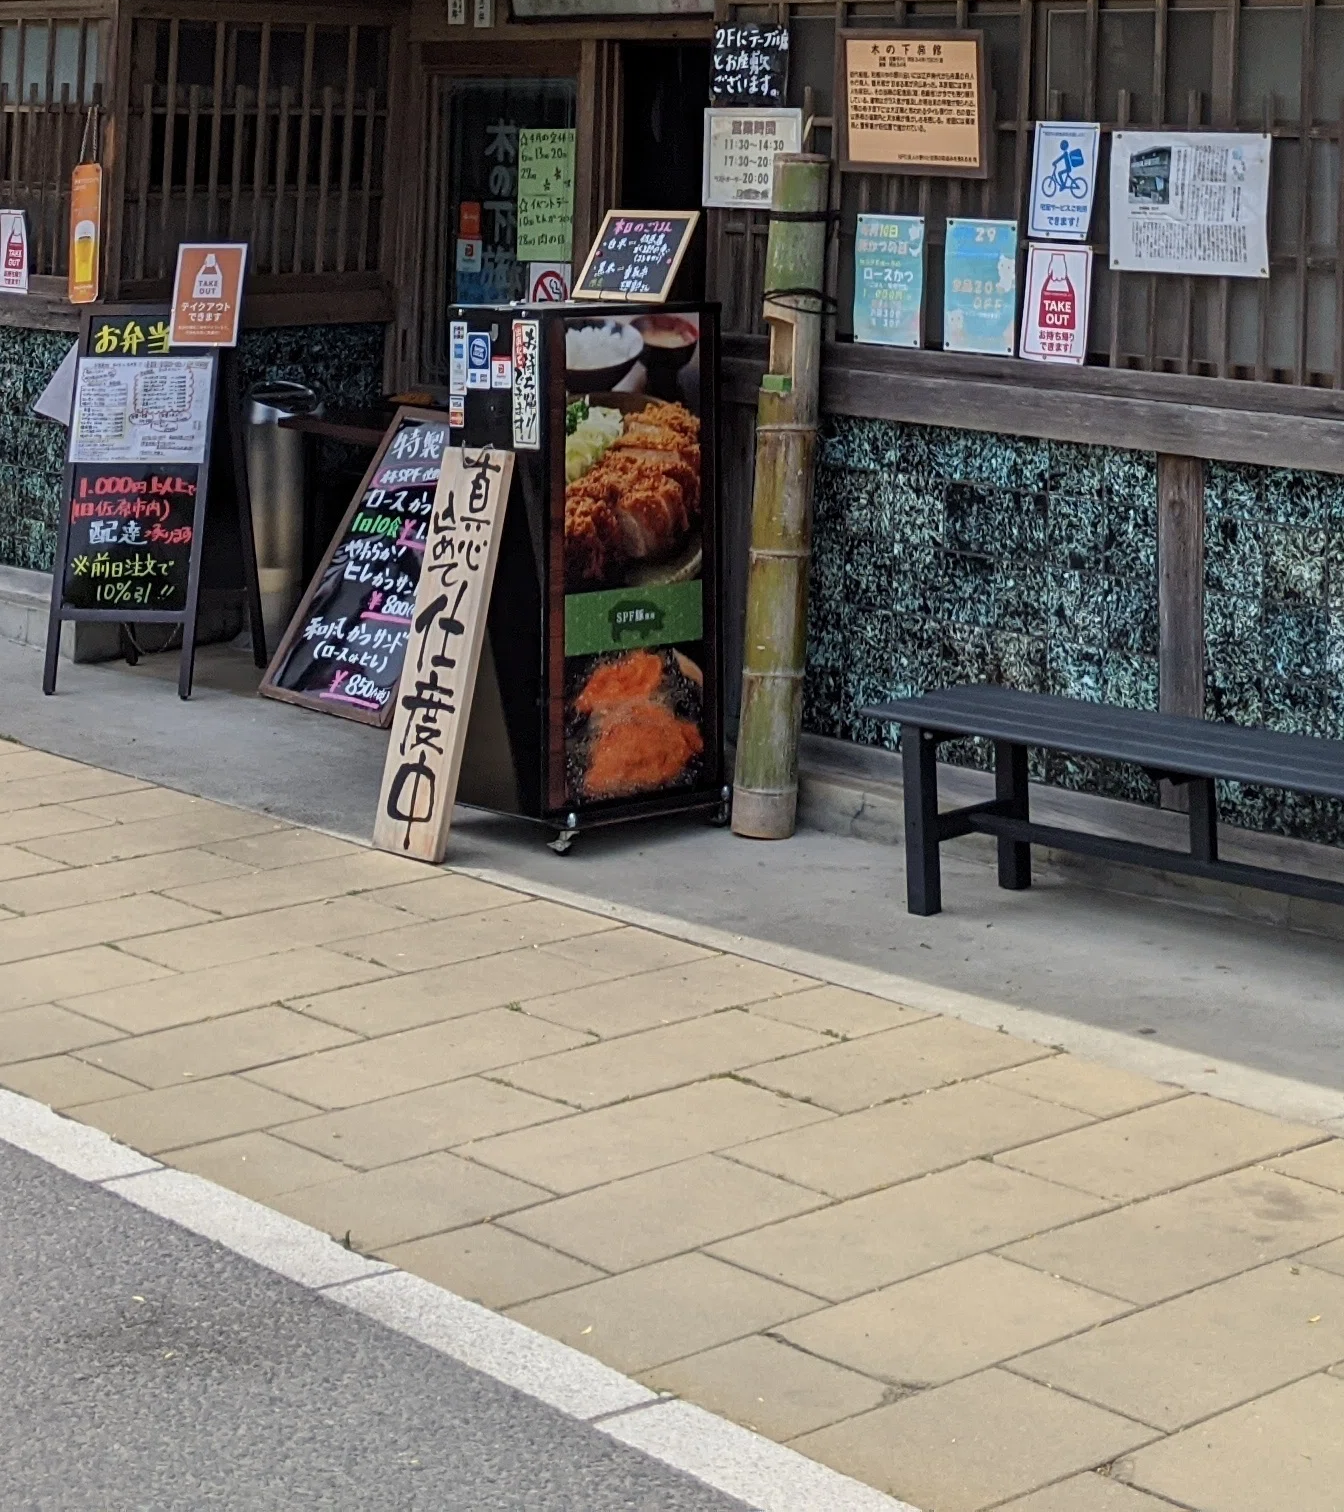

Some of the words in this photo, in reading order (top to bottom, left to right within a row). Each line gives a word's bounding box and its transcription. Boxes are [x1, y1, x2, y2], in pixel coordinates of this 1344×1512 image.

[732, 120, 777, 136] 営業時間
[863, 267, 914, 283] ロースかつ
[181, 302, 231, 312] テイクアウト
[1043, 299, 1072, 313] TAKE
[1045, 313, 1070, 326] OUT
[94, 320, 170, 355] お弁当
[392, 430, 444, 460] 特製
[458, 453, 502, 571] 真心
[426, 490, 458, 586] 込めて
[386, 580, 469, 850] 仕度中
